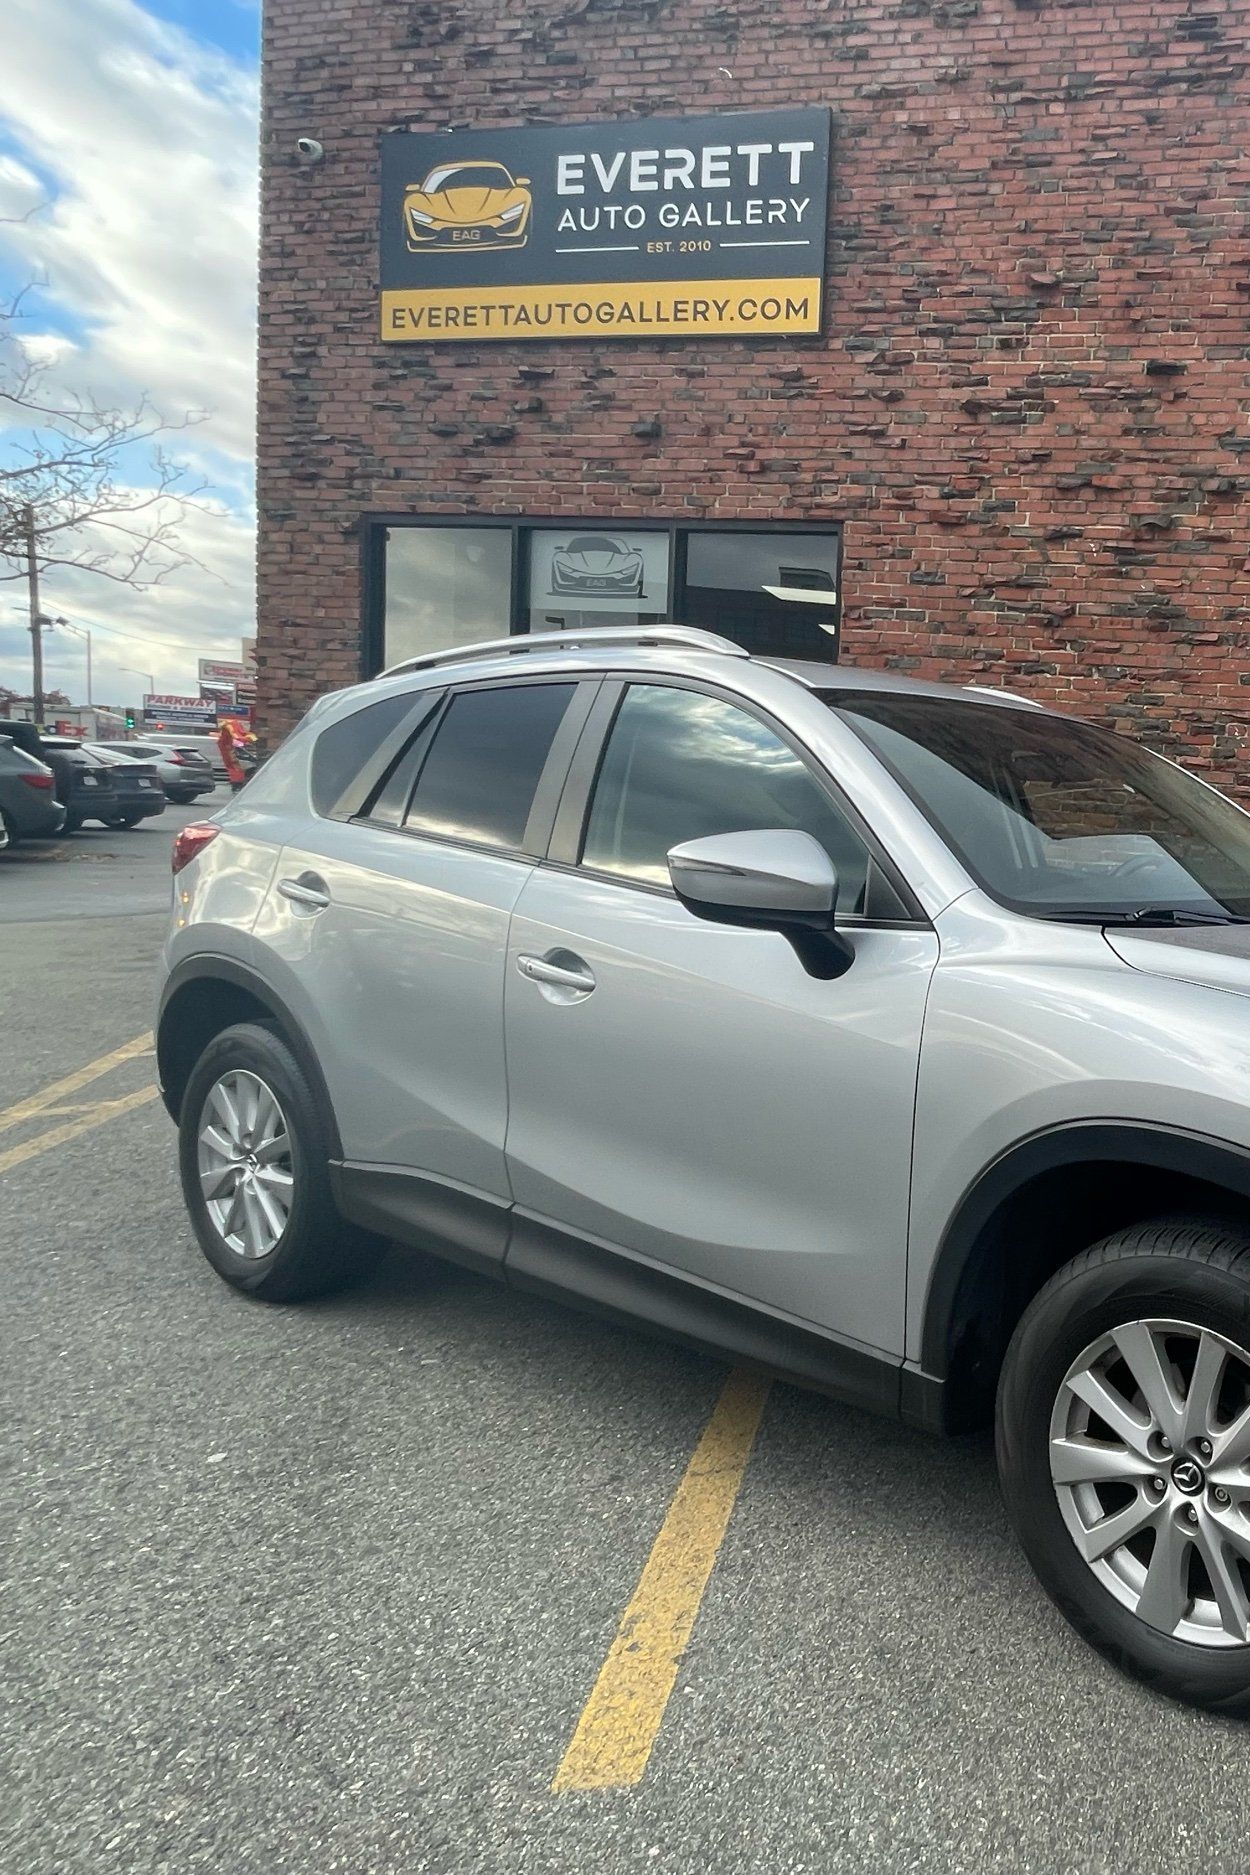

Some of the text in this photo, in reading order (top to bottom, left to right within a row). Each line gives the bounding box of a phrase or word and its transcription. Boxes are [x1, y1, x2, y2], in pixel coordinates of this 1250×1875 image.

[556, 141, 815, 196] EVERETT
[557, 198, 811, 233] AUTO GALLERY
[452, 229, 481, 242] EAG
[647, 240, 712, 253] EST. 2010
[391, 297, 809, 329] EVERETTAUTOGALLERY.COM
[147, 694, 213, 707] PARKWAY
